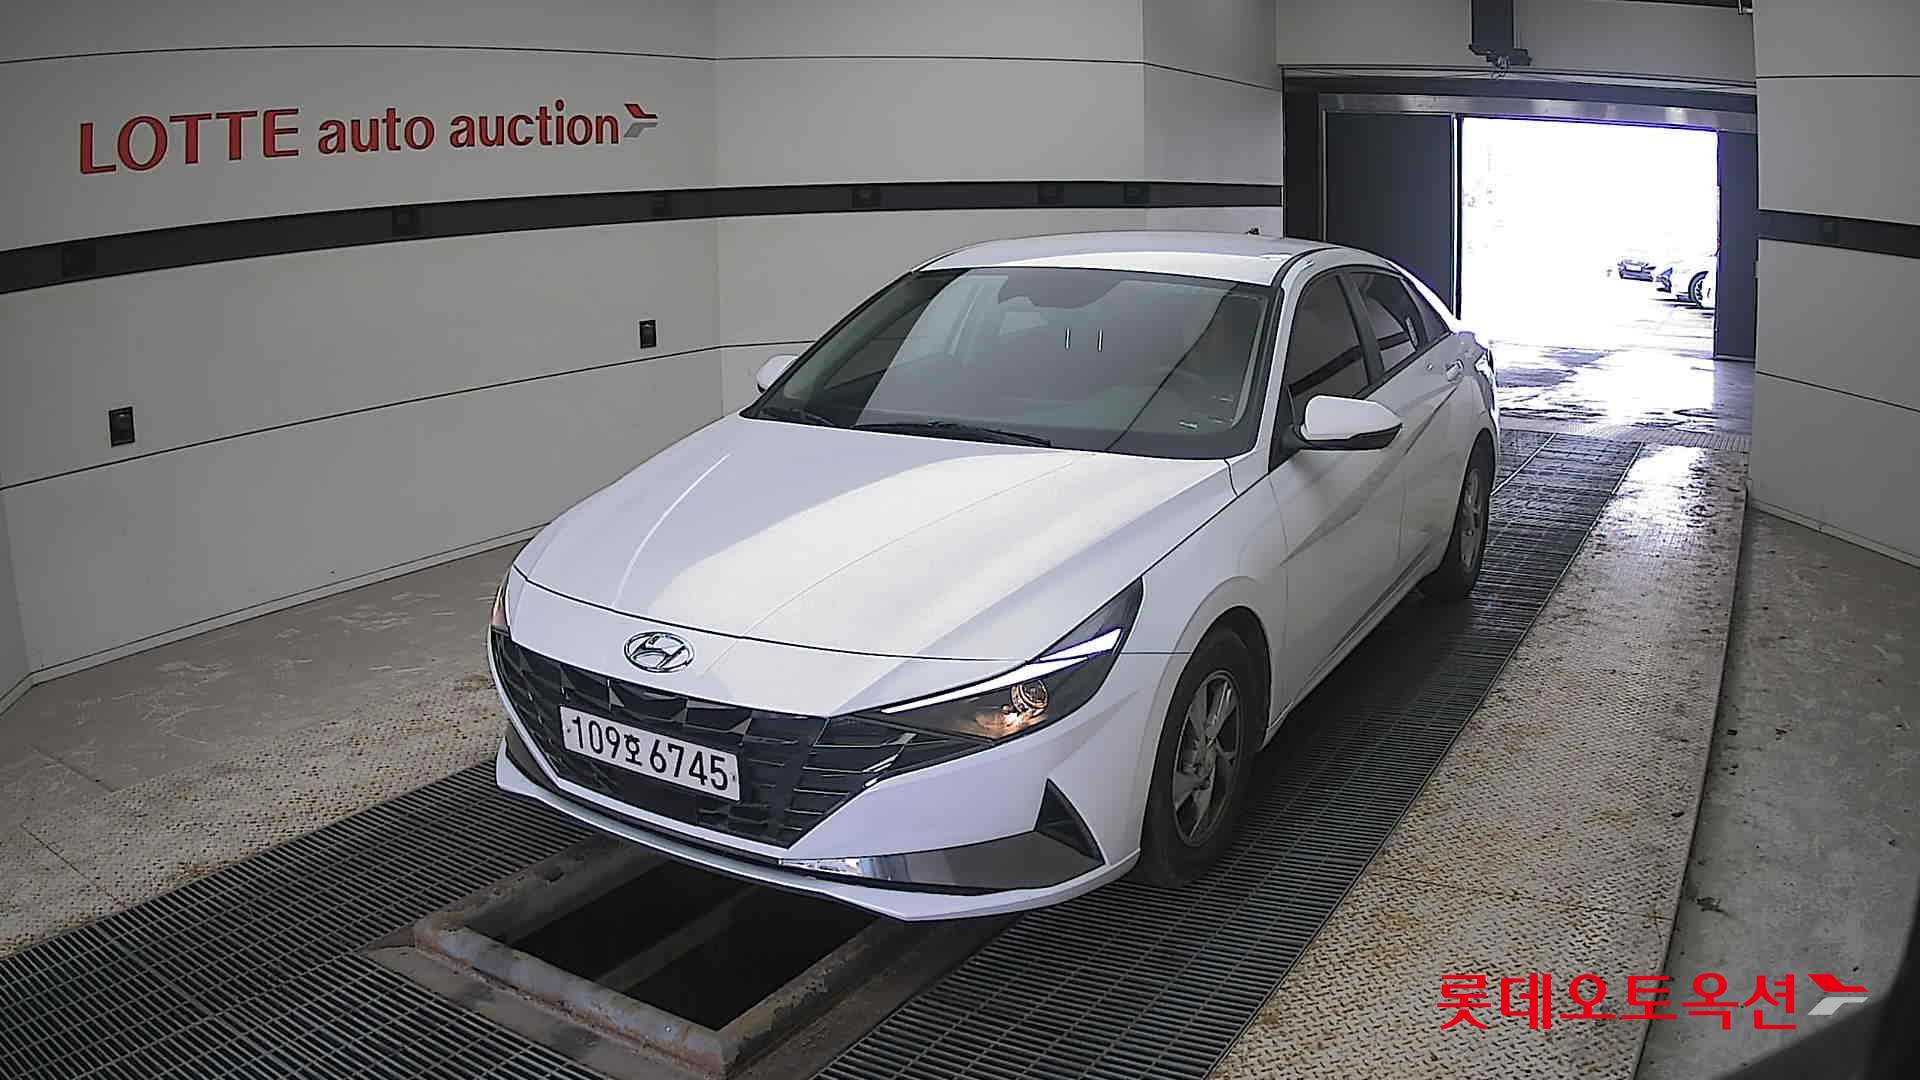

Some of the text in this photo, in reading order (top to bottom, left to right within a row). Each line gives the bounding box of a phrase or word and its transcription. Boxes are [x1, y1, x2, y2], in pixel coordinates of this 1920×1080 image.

[79, 99, 620, 175] LOTTE auto auction
